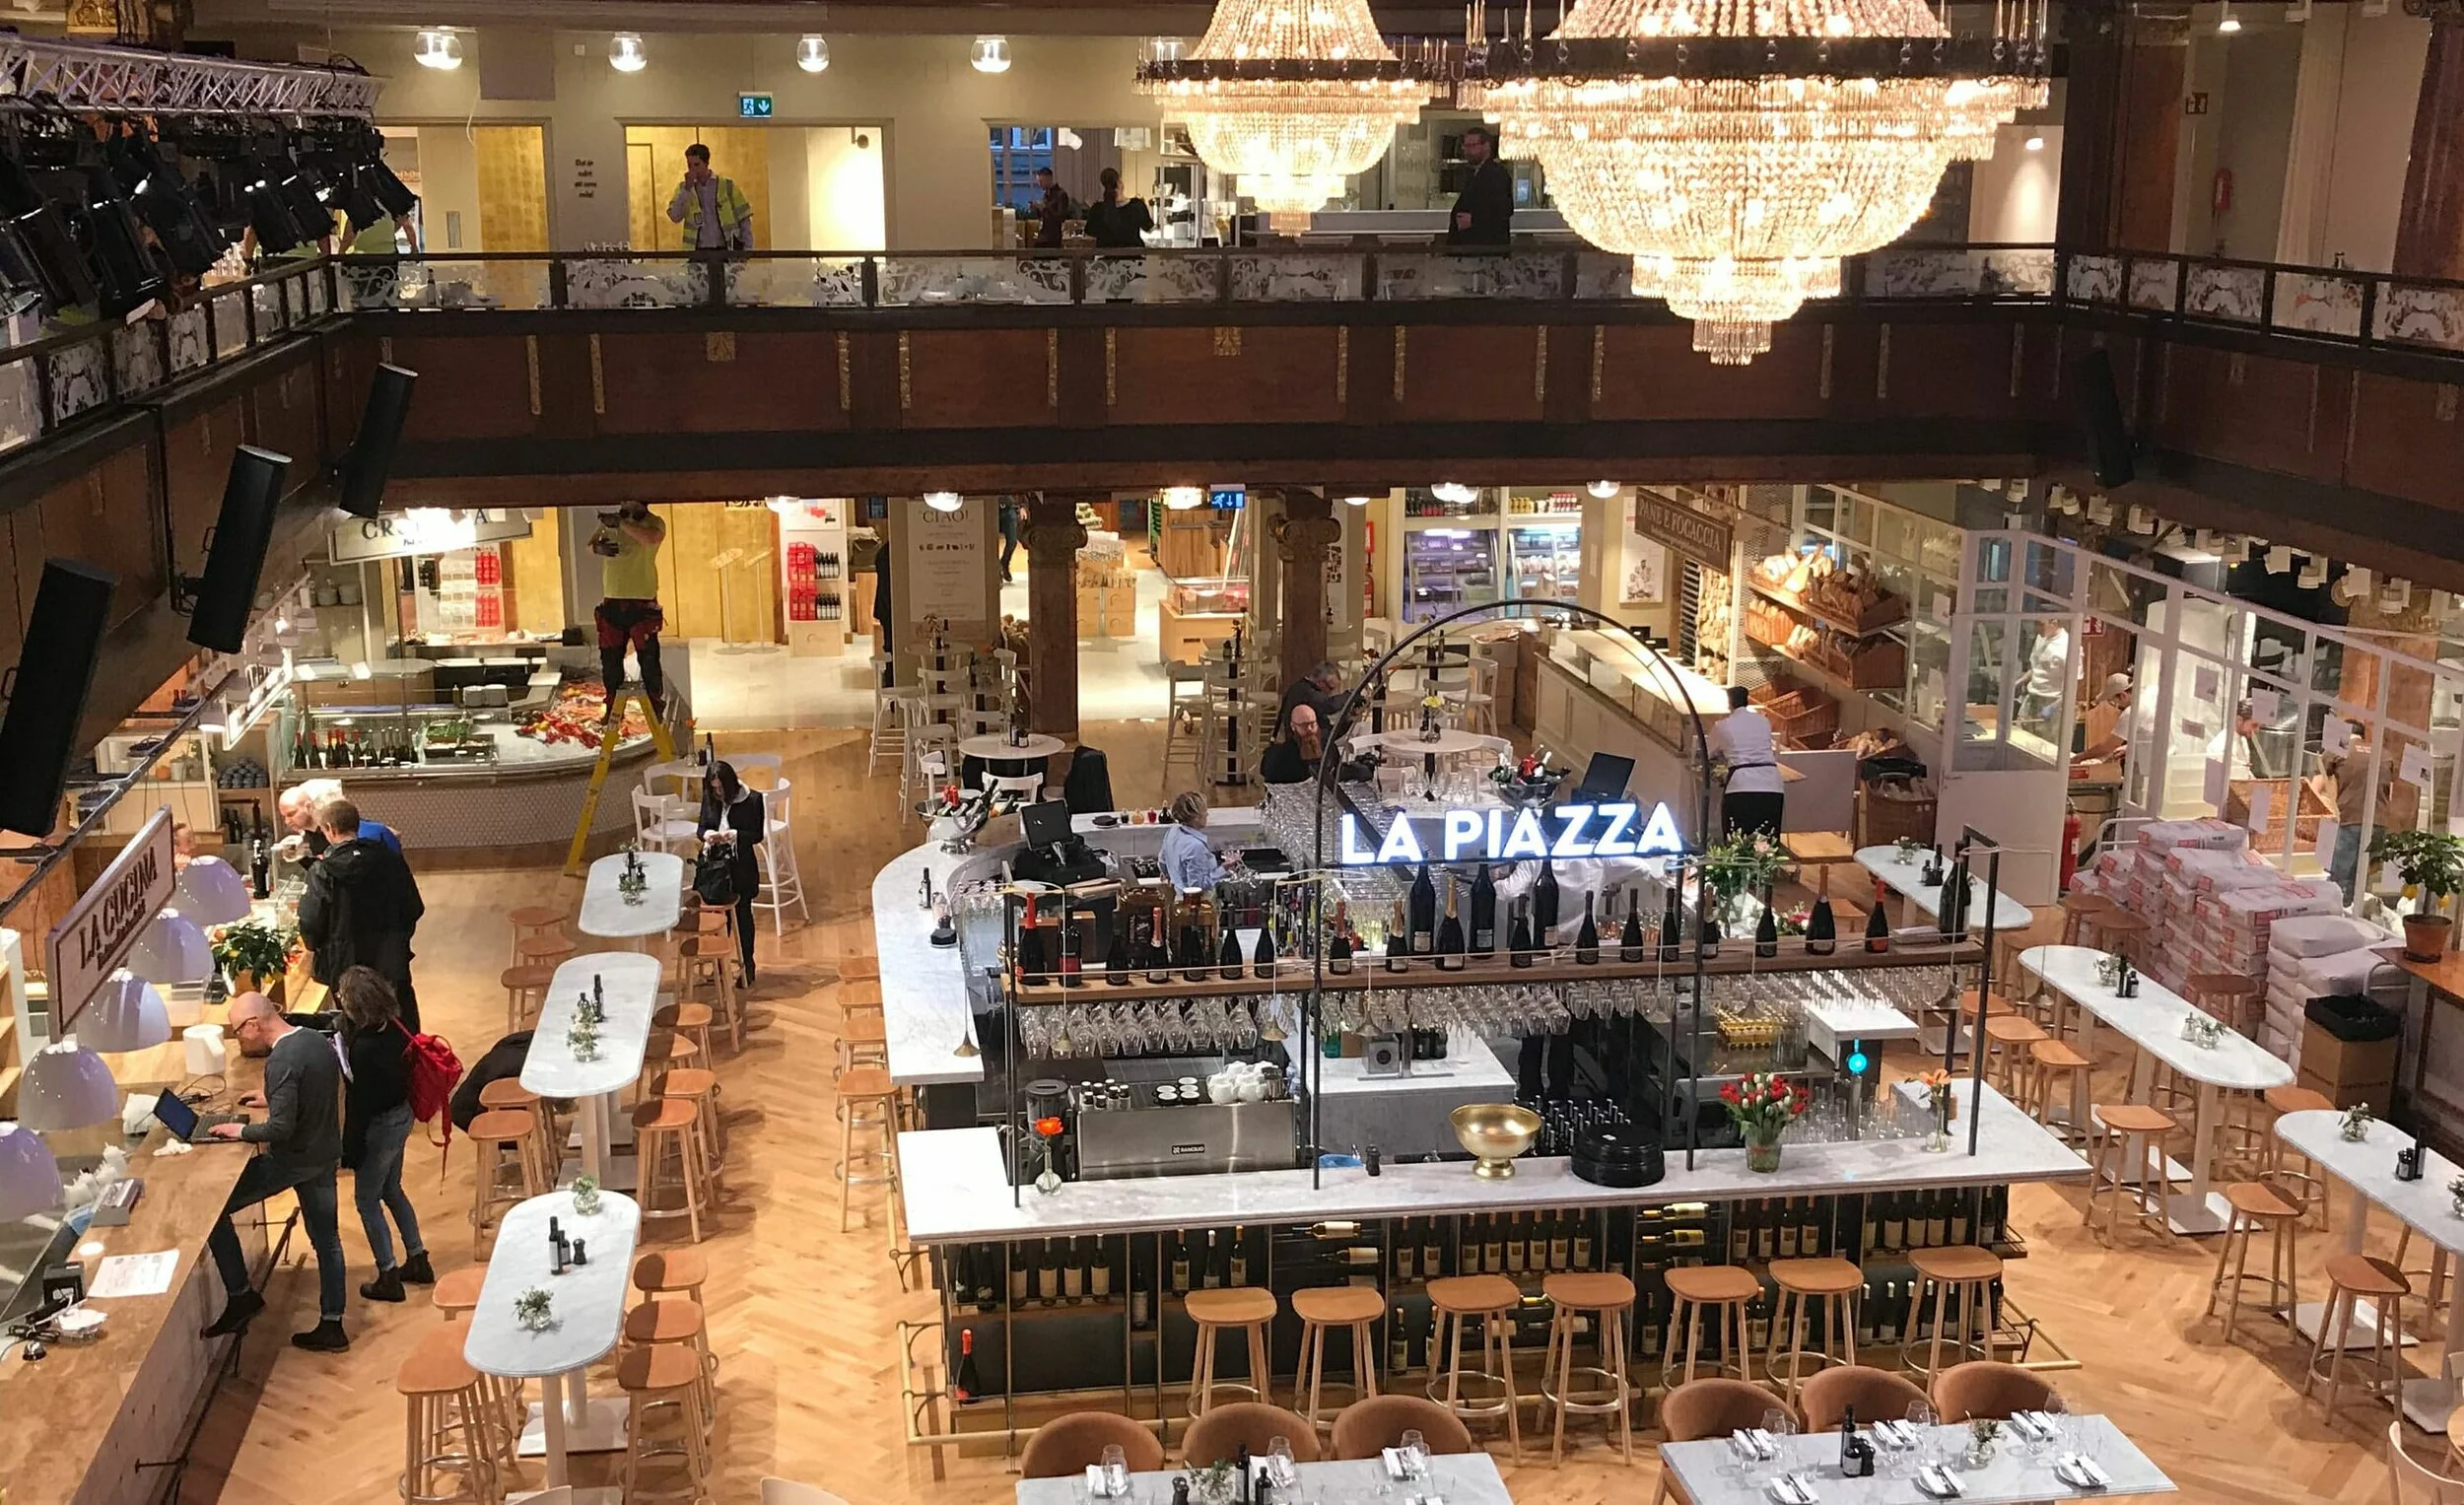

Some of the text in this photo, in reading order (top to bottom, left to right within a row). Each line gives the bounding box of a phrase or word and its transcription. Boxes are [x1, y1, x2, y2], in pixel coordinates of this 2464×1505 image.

[1639, 499, 1662, 524] PANE
[1664, 511, 1670, 528] E
[1671, 513, 1721, 552] FOCACCIA
[1341, 801, 1684, 865] LA PIAZZA
[79, 914, 102, 970] LA
[103, 847, 158, 936] CUCINA
